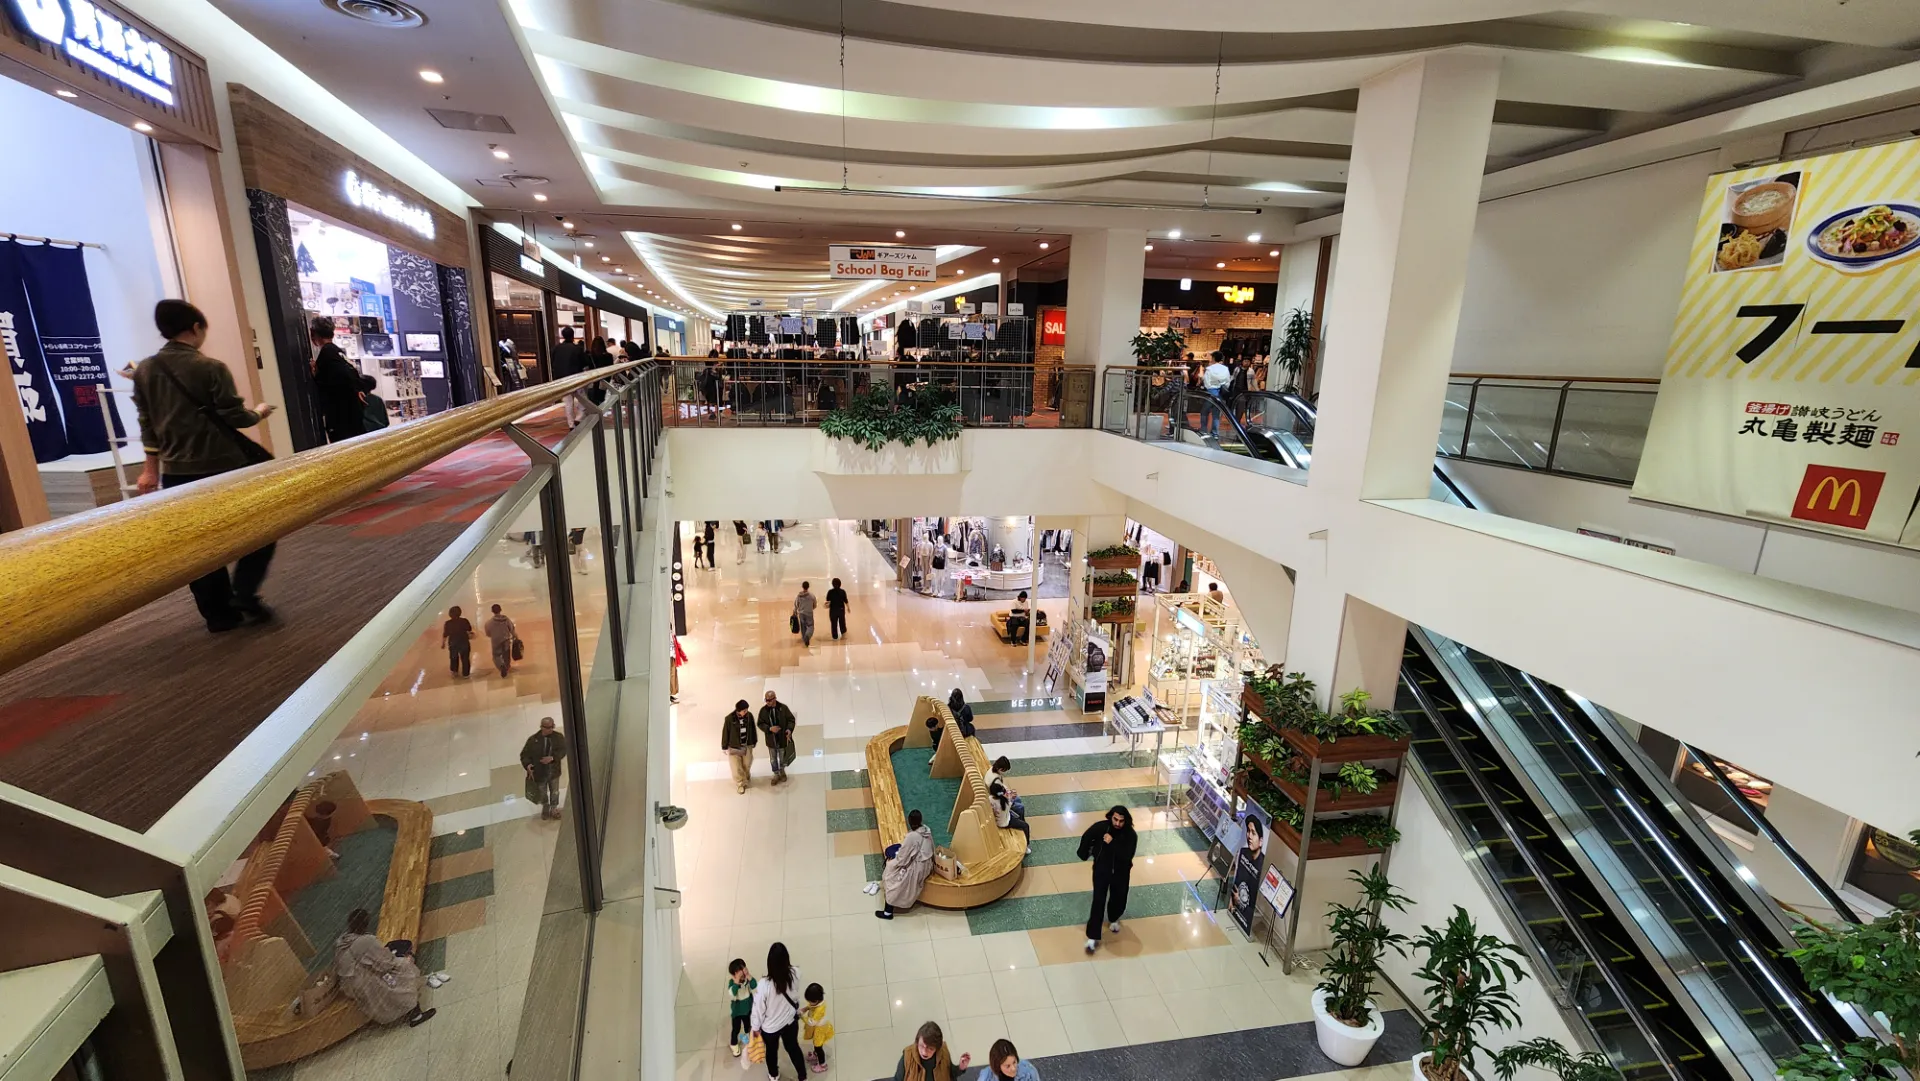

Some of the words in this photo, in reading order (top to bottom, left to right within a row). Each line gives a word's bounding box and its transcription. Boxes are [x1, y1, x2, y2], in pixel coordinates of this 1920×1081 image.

[877, 252, 917, 260] ギアーズジャム
[837, 263, 877, 275] School
[881, 265, 904, 278] Bag
[908, 266, 930, 277] Fair
[1045, 321, 1066, 335] SAL
[1736, 304, 1920, 368] フー
[1747, 402, 1790, 416] 釜揚げ
[1791, 404, 1882, 423] 讃岐うどん
[1738, 416, 1879, 449] 丸亀製麺
